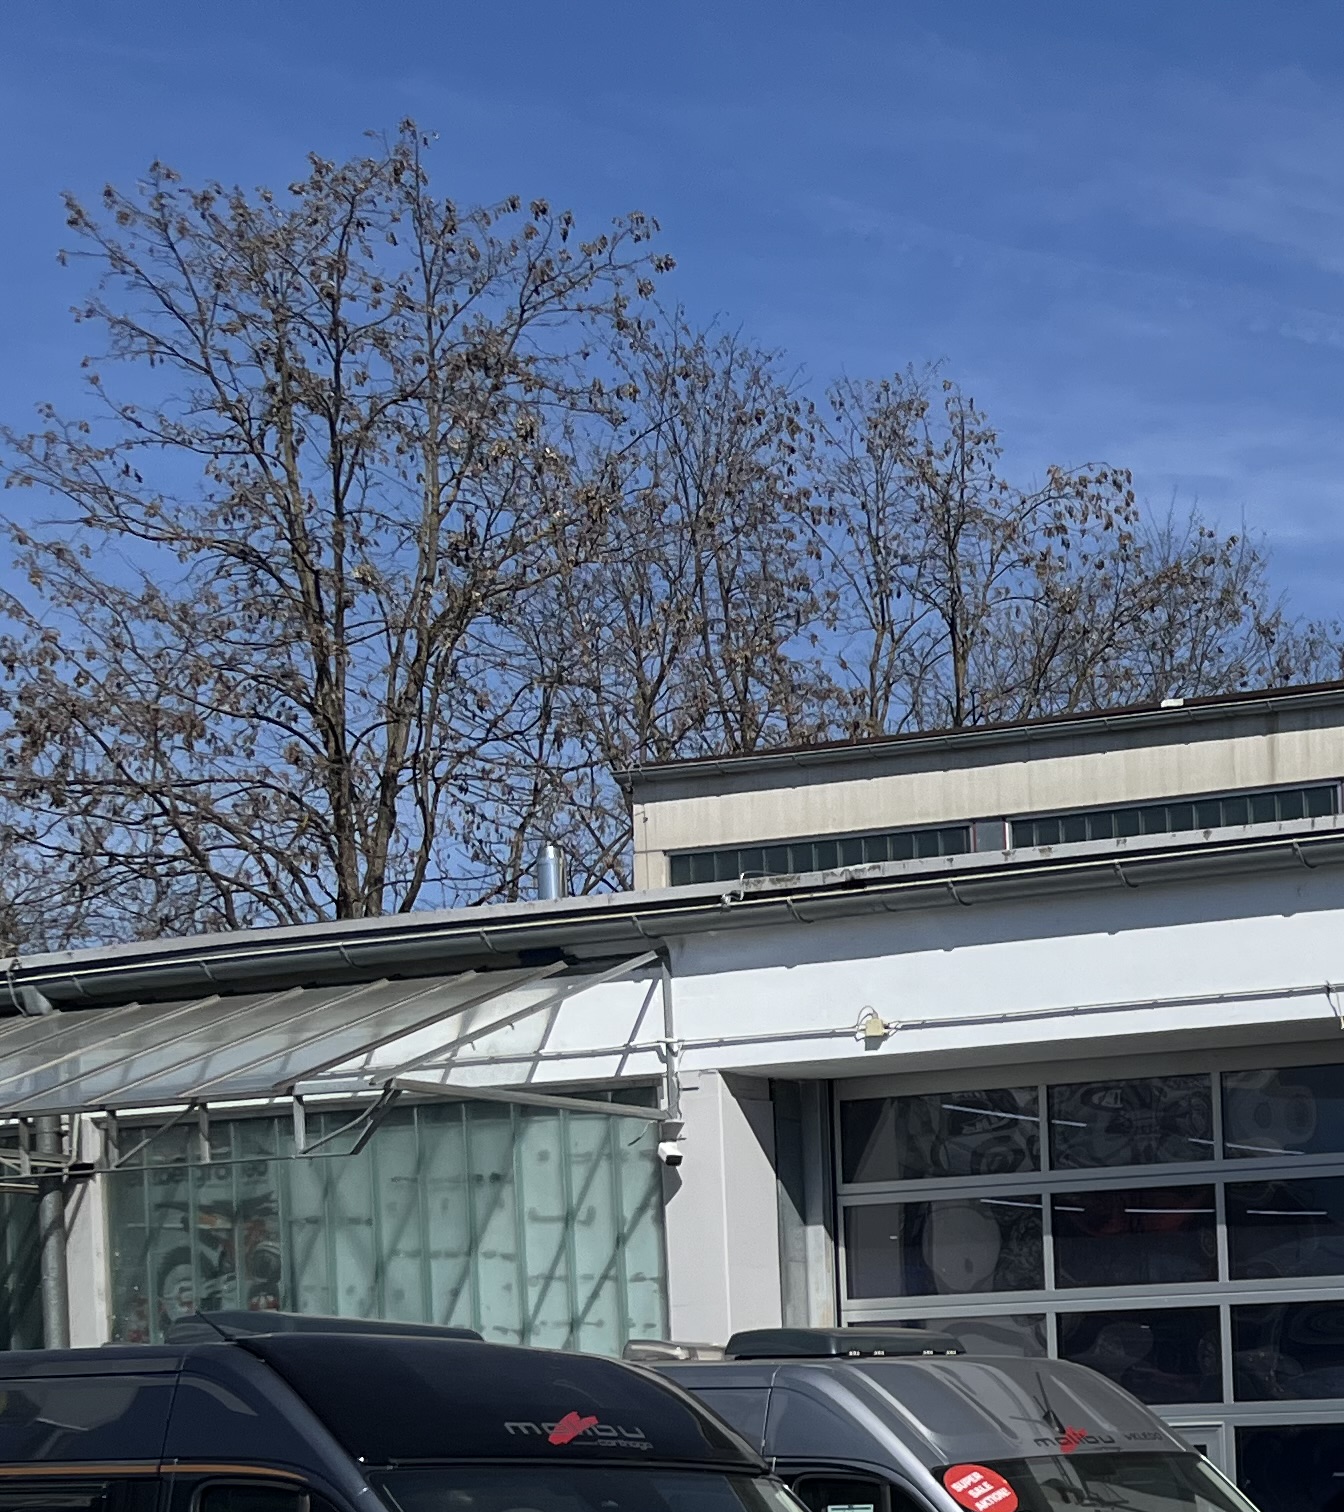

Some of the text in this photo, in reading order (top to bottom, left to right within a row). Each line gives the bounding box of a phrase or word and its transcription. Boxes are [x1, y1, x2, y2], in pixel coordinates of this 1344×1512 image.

[504, 1421, 645, 1438] mibu
[950, 1471, 984, 1492] SUPER
[967, 1481, 995, 1498] SALE
